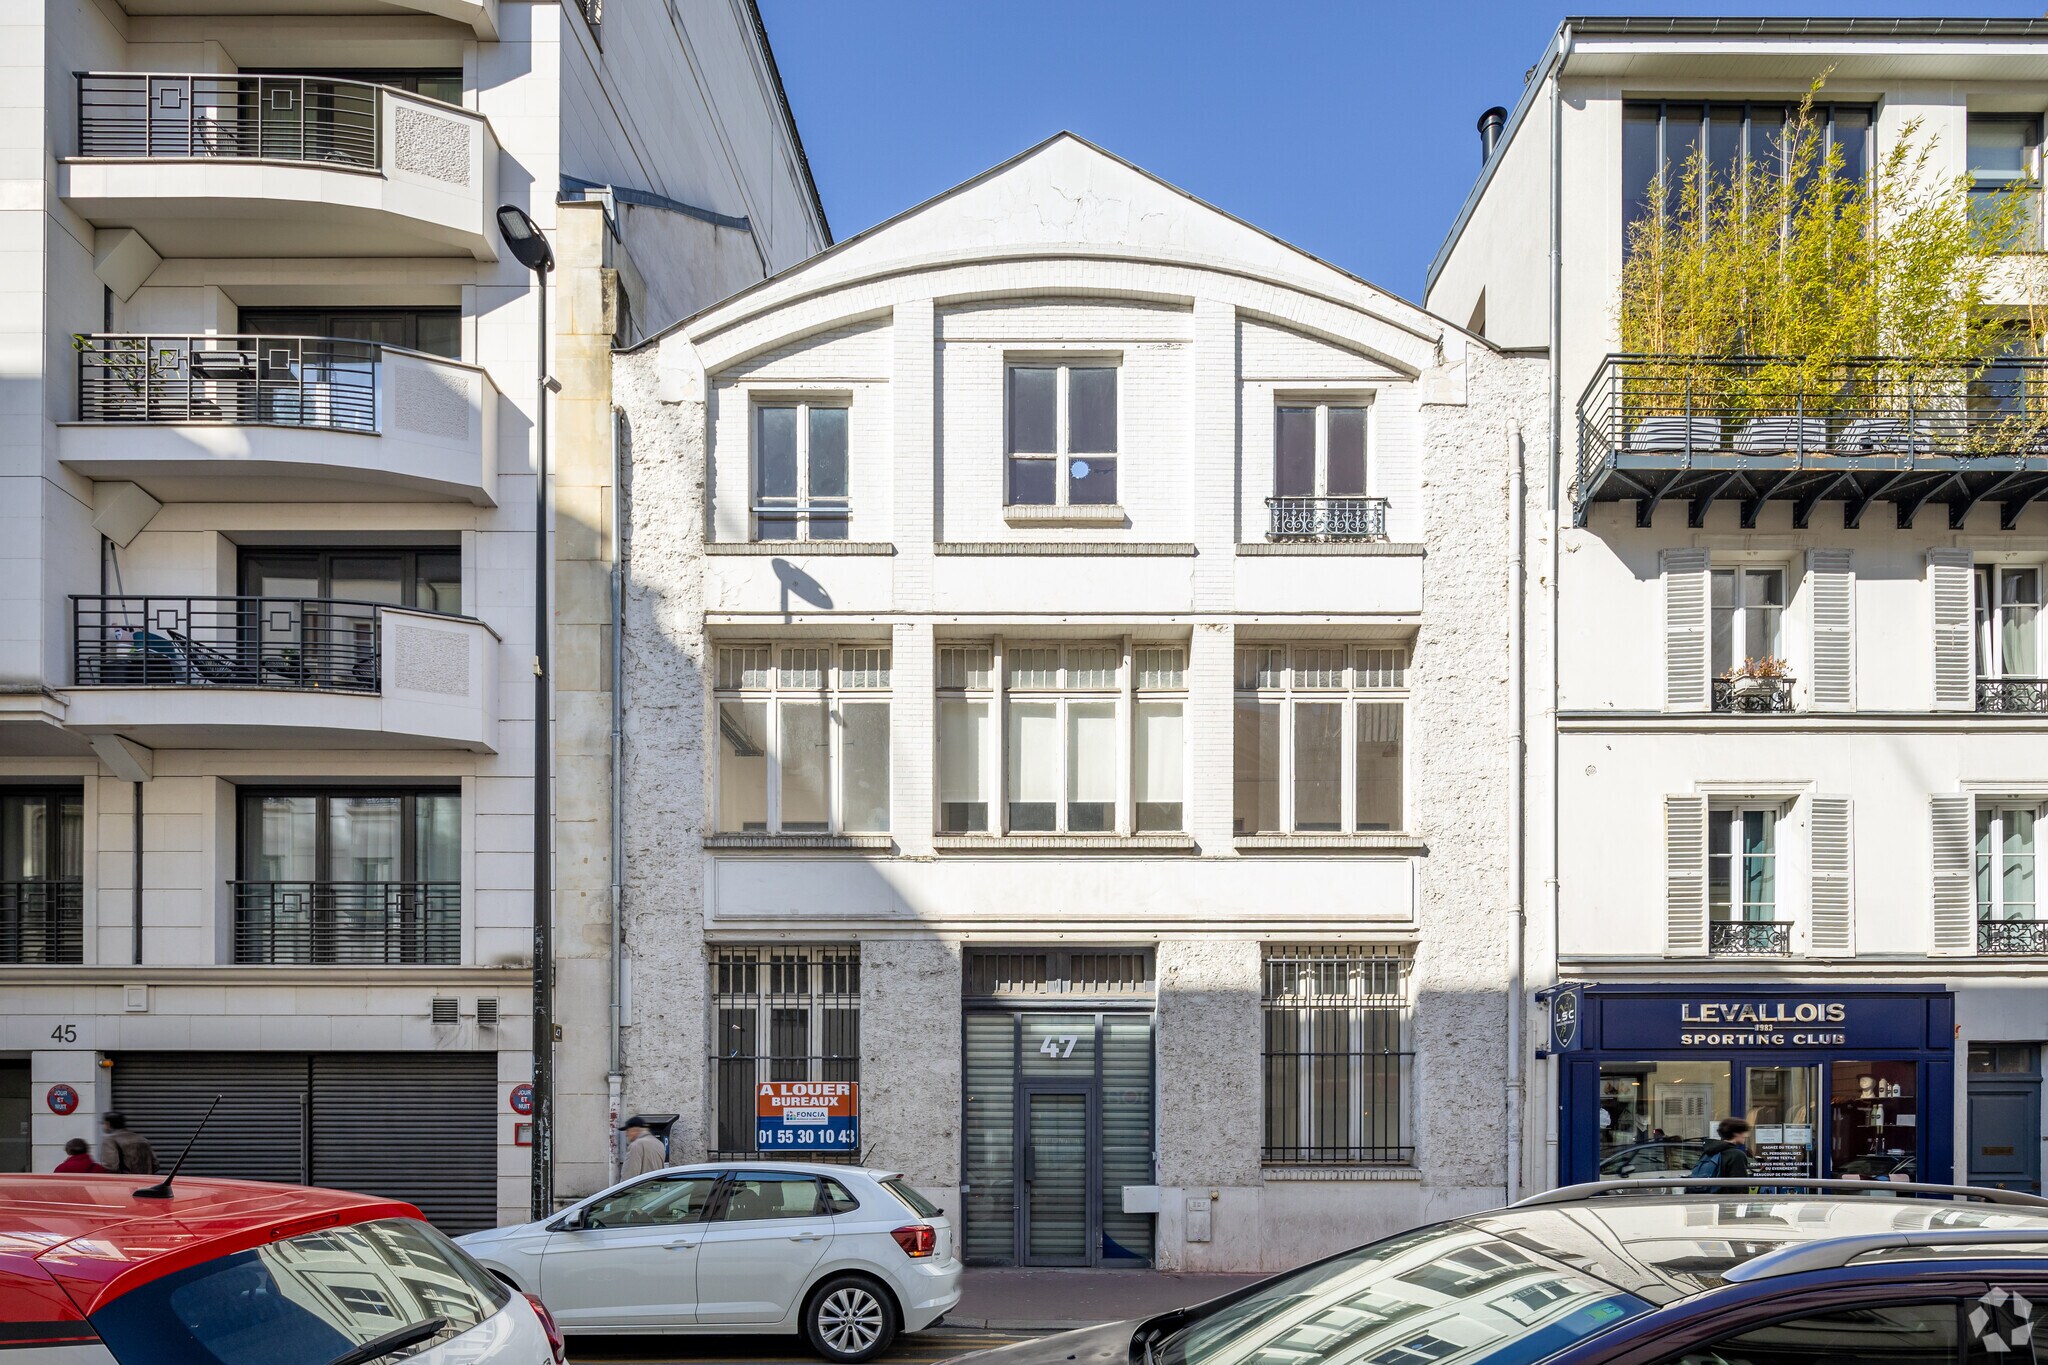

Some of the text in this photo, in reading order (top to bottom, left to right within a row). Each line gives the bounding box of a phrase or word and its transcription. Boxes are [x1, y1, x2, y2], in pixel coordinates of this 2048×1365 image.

[1556, 1009, 1575, 1023] LSC
[1681, 1003, 1846, 1022] LEVALLOIS
[50, 1024, 77, 1043] 45
[1680, 1034, 1846, 1045] SPORTING CLUB
[1040, 1035, 1077, 1058] 47
[759, 1084, 850, 1096] A LOUER
[771, 1097, 839, 1107] BUREAUX
[759, 1129, 855, 1144] 01 55 30 10 43
